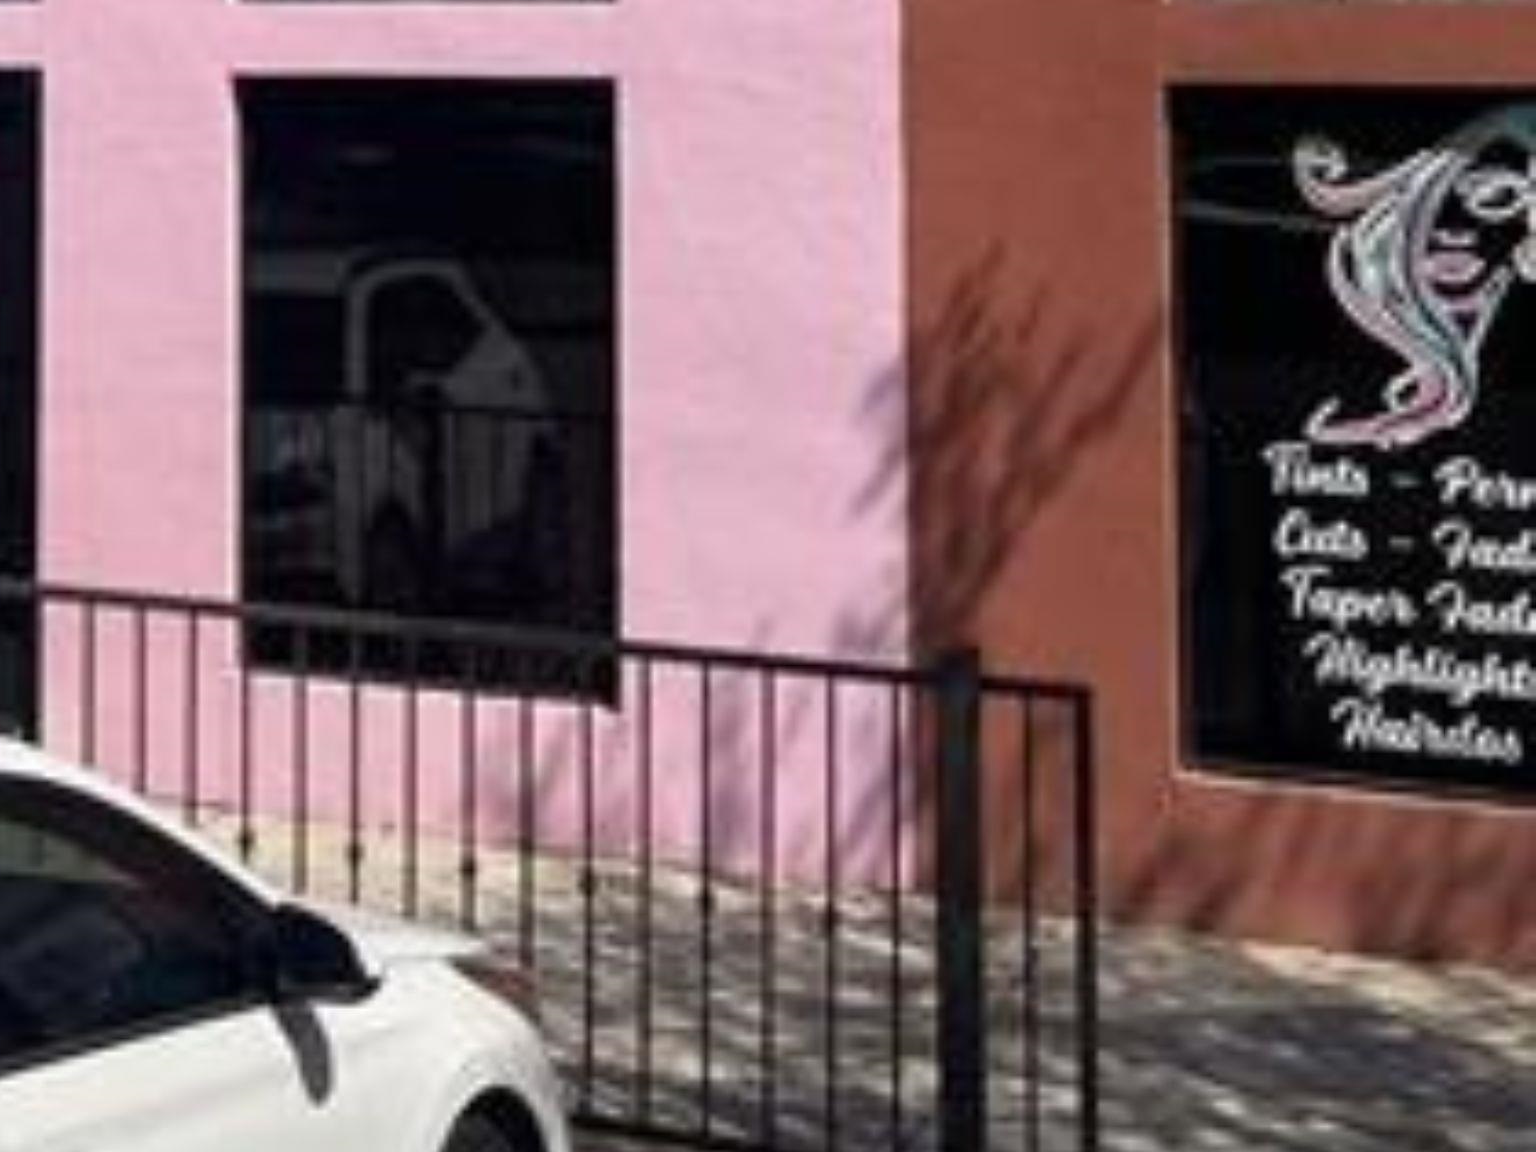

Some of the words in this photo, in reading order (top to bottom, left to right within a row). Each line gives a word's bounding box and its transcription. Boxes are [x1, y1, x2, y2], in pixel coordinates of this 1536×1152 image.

[1262, 440, 1369, 495] Tints
[1272, 506, 1368, 560] Cuts
[1431, 519, 1536, 571] Fad
[1278, 565, 1418, 630] Taper
[1329, 697, 1522, 764] Hairdos
